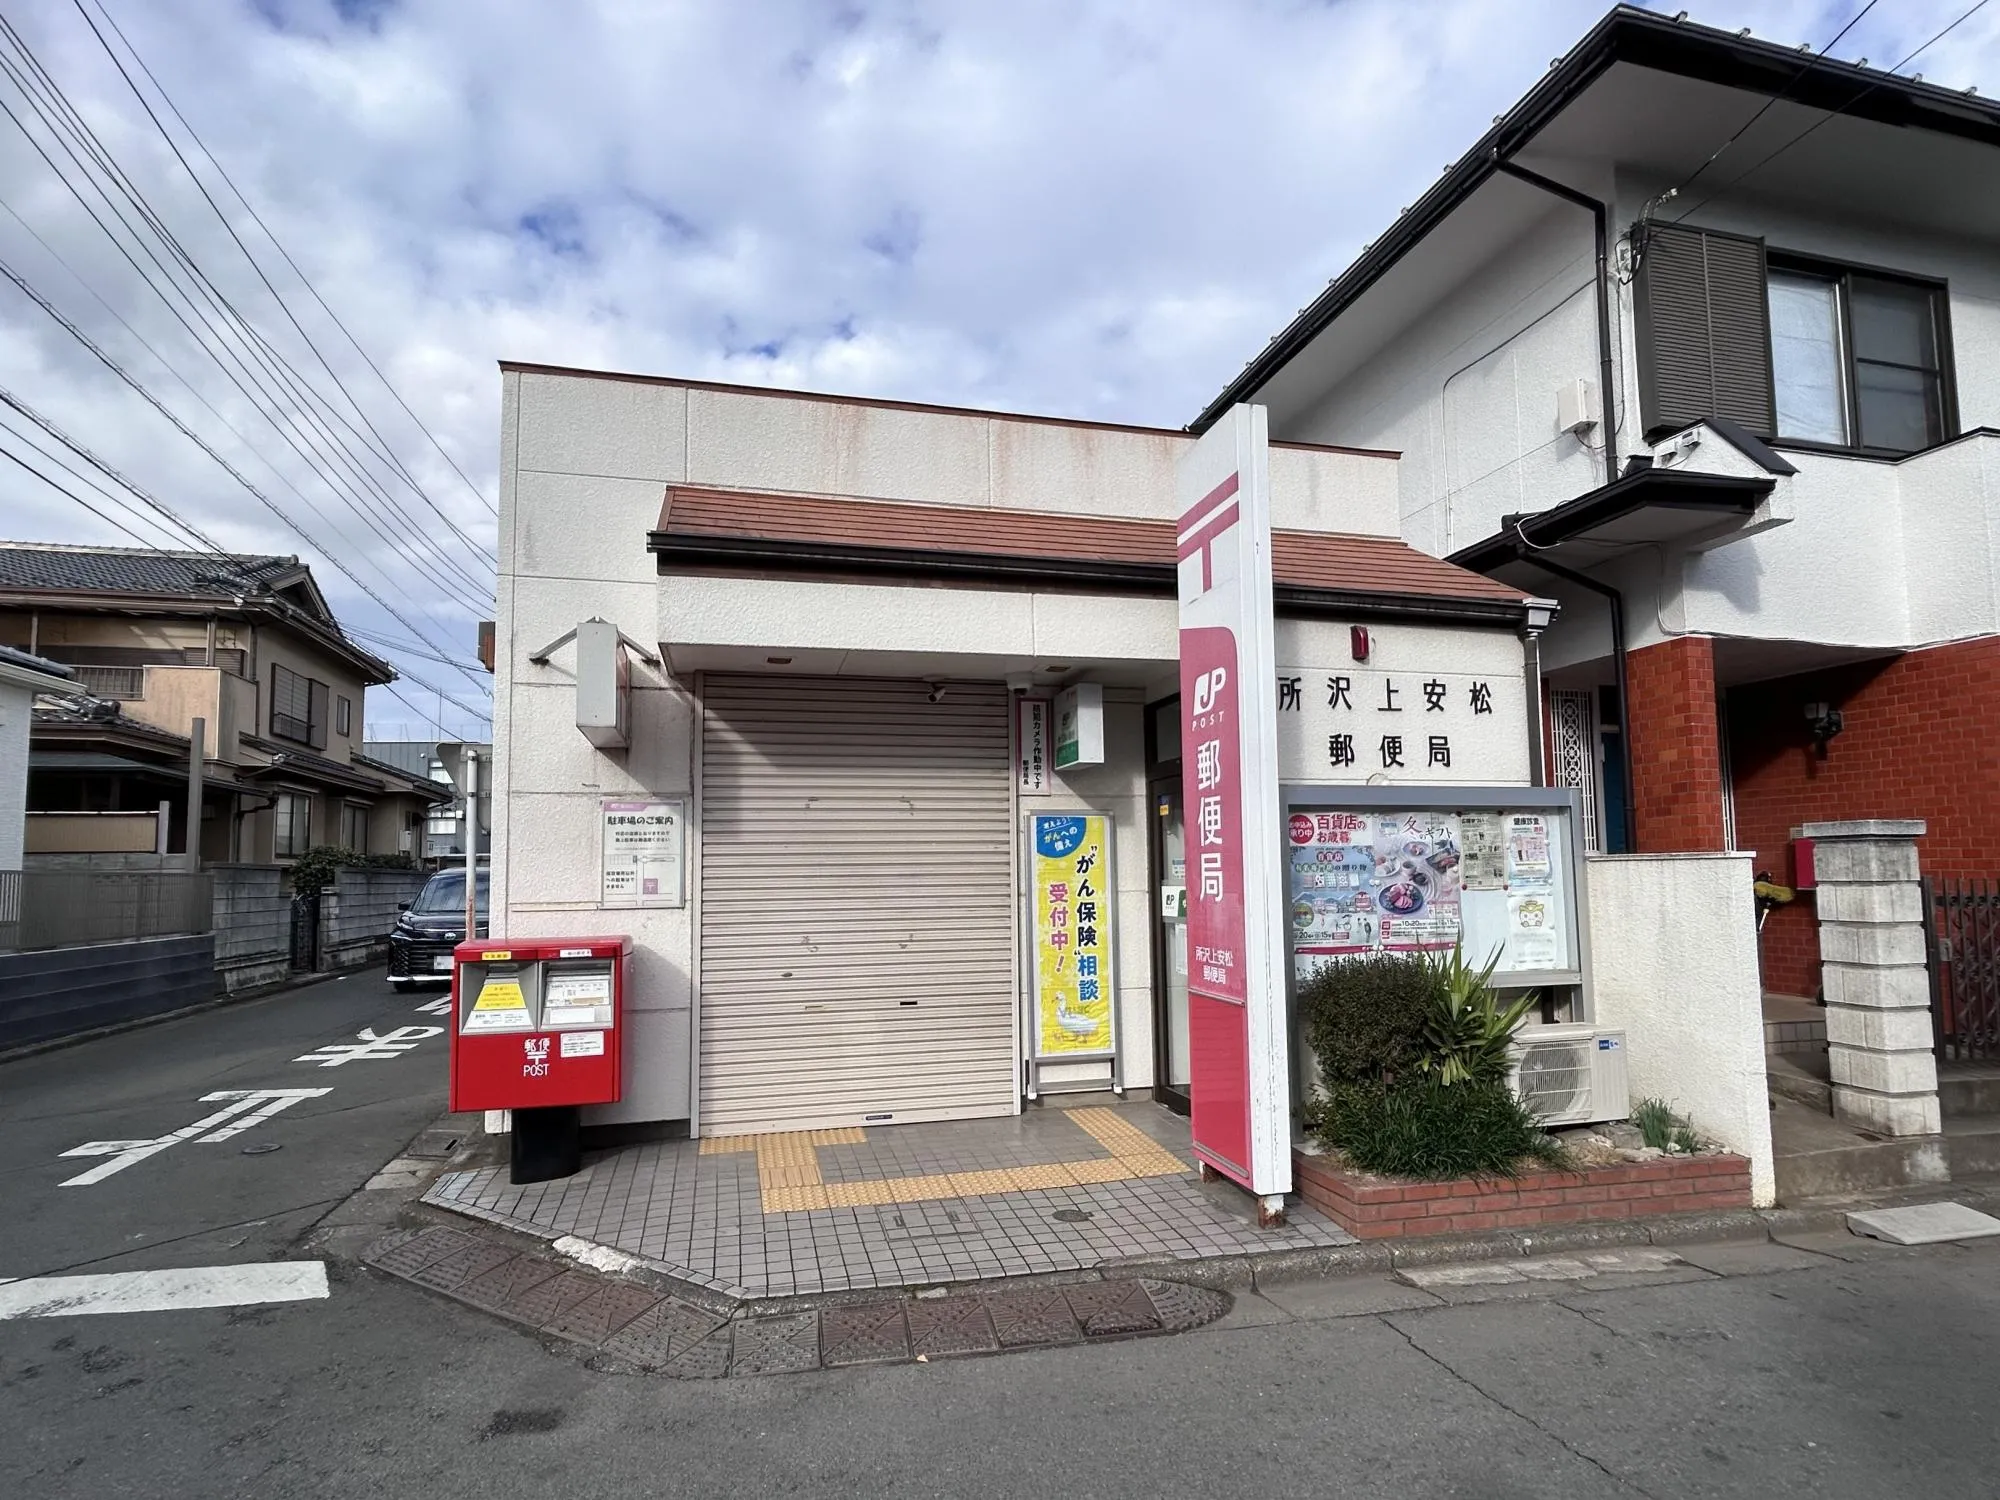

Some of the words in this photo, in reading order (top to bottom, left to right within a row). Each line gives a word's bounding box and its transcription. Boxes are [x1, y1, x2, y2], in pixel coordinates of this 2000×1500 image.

[1278, 677, 1492, 715] 所沢上安松
[1192, 711, 1224, 732] POST
[1329, 733, 1451, 768] 郵便局
[607, 816, 674, 825] 駐車場のご案内
[1197, 741, 1224, 902] 郵便局
[1316, 814, 1366, 830] 百貨店の
[1044, 826, 1078, 844] がんへの
[1317, 831, 1351, 844] お歳暮
[1196, 946, 1233, 967] 所沢上安松
[1203, 965, 1226, 985] 郵便局
[524, 1038, 550, 1052] 郵便
[523, 1063, 550, 1077] POST
